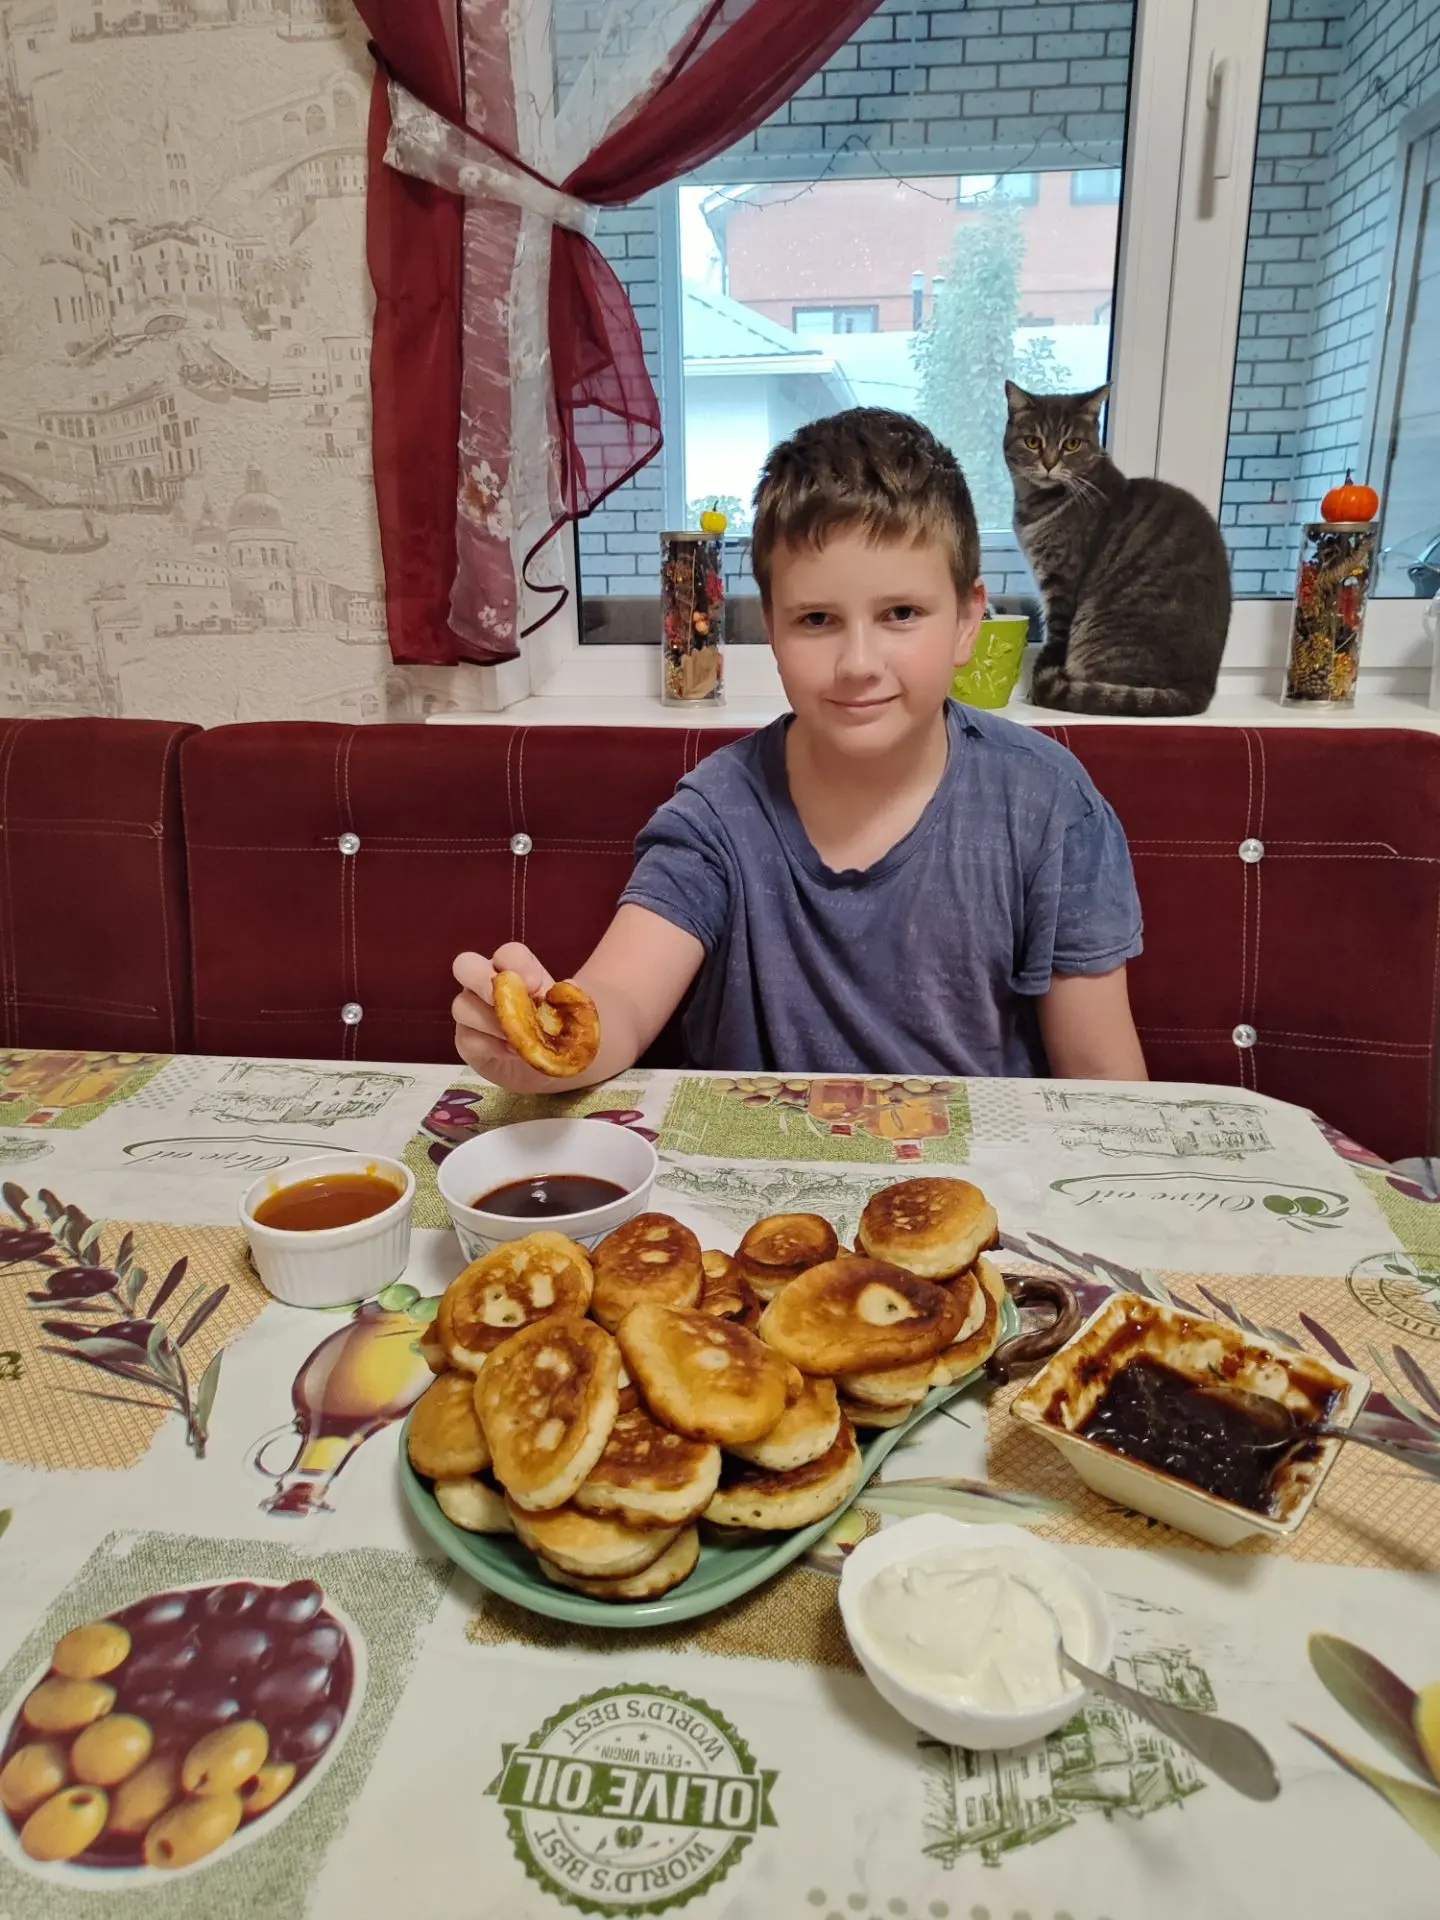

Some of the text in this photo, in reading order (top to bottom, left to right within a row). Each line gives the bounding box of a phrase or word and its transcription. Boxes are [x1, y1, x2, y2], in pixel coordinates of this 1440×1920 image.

[123, 1151, 193, 1165] oil
[1076, 1190, 1255, 1212] Olive oil
[562, 1700, 725, 1762] WORLD'S BEST
[600, 1743, 683, 1767] EXTRA VIRGIN
[516, 1756, 754, 1827] OLIVE OIL
[534, 1828, 715, 1894] WORLD'S BEST
